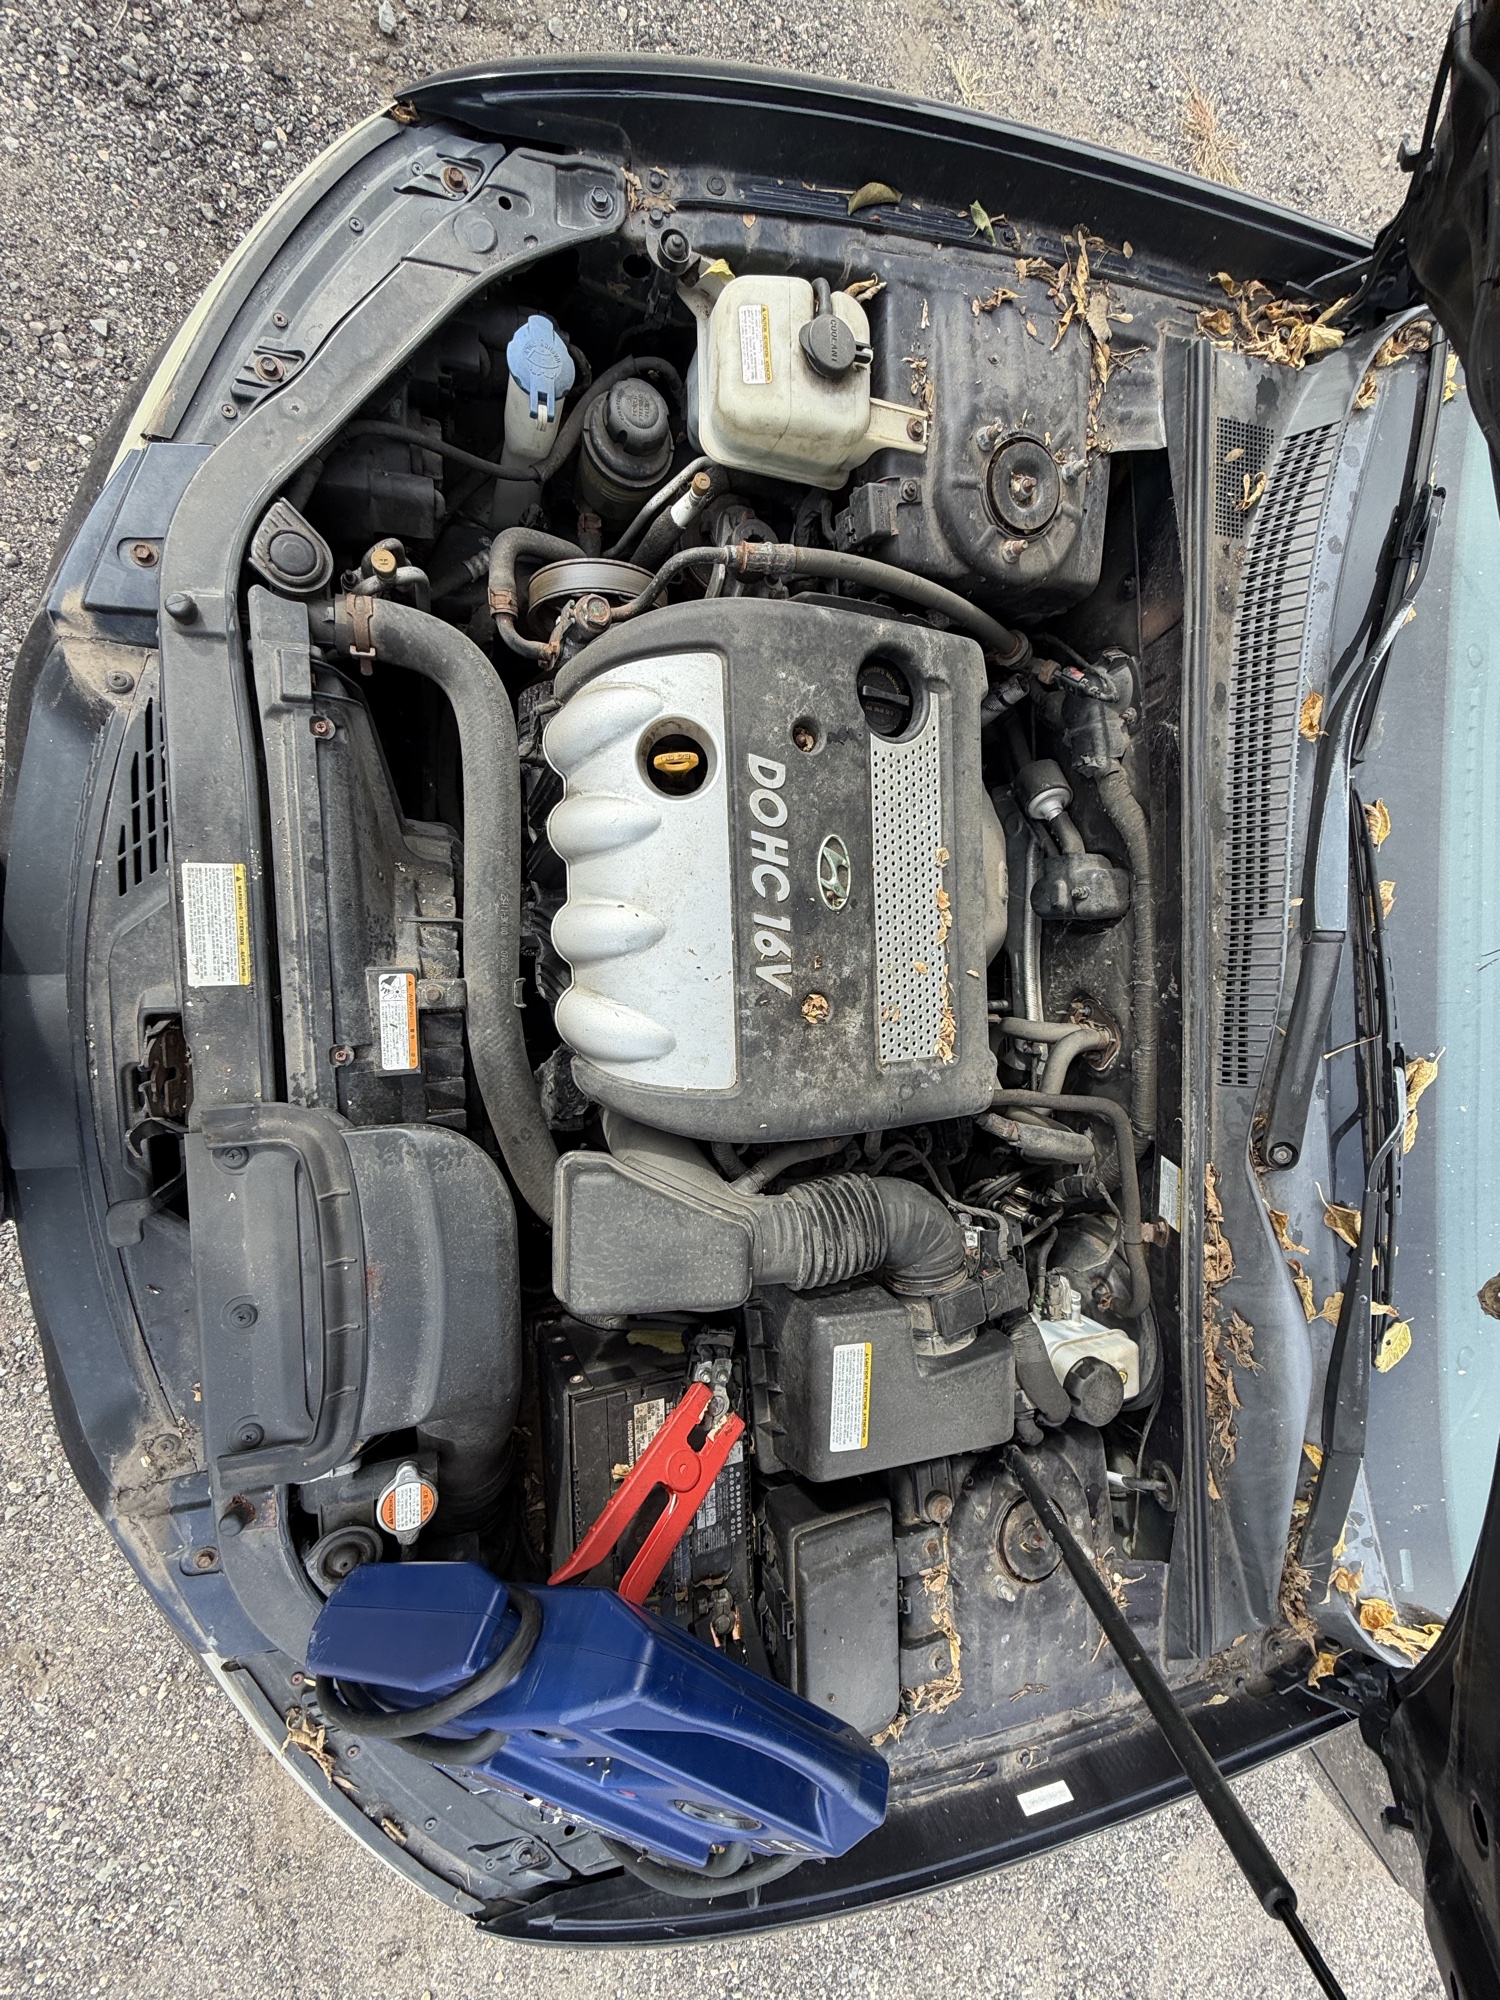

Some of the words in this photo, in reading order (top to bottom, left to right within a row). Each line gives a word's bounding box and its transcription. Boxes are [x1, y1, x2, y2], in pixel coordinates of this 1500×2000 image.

[830, 319, 838, 363] COOLANT
[885, 671, 901, 695] MANUAL
[747, 753, 790, 902] DOHC
[753, 913, 792, 997] 16V
